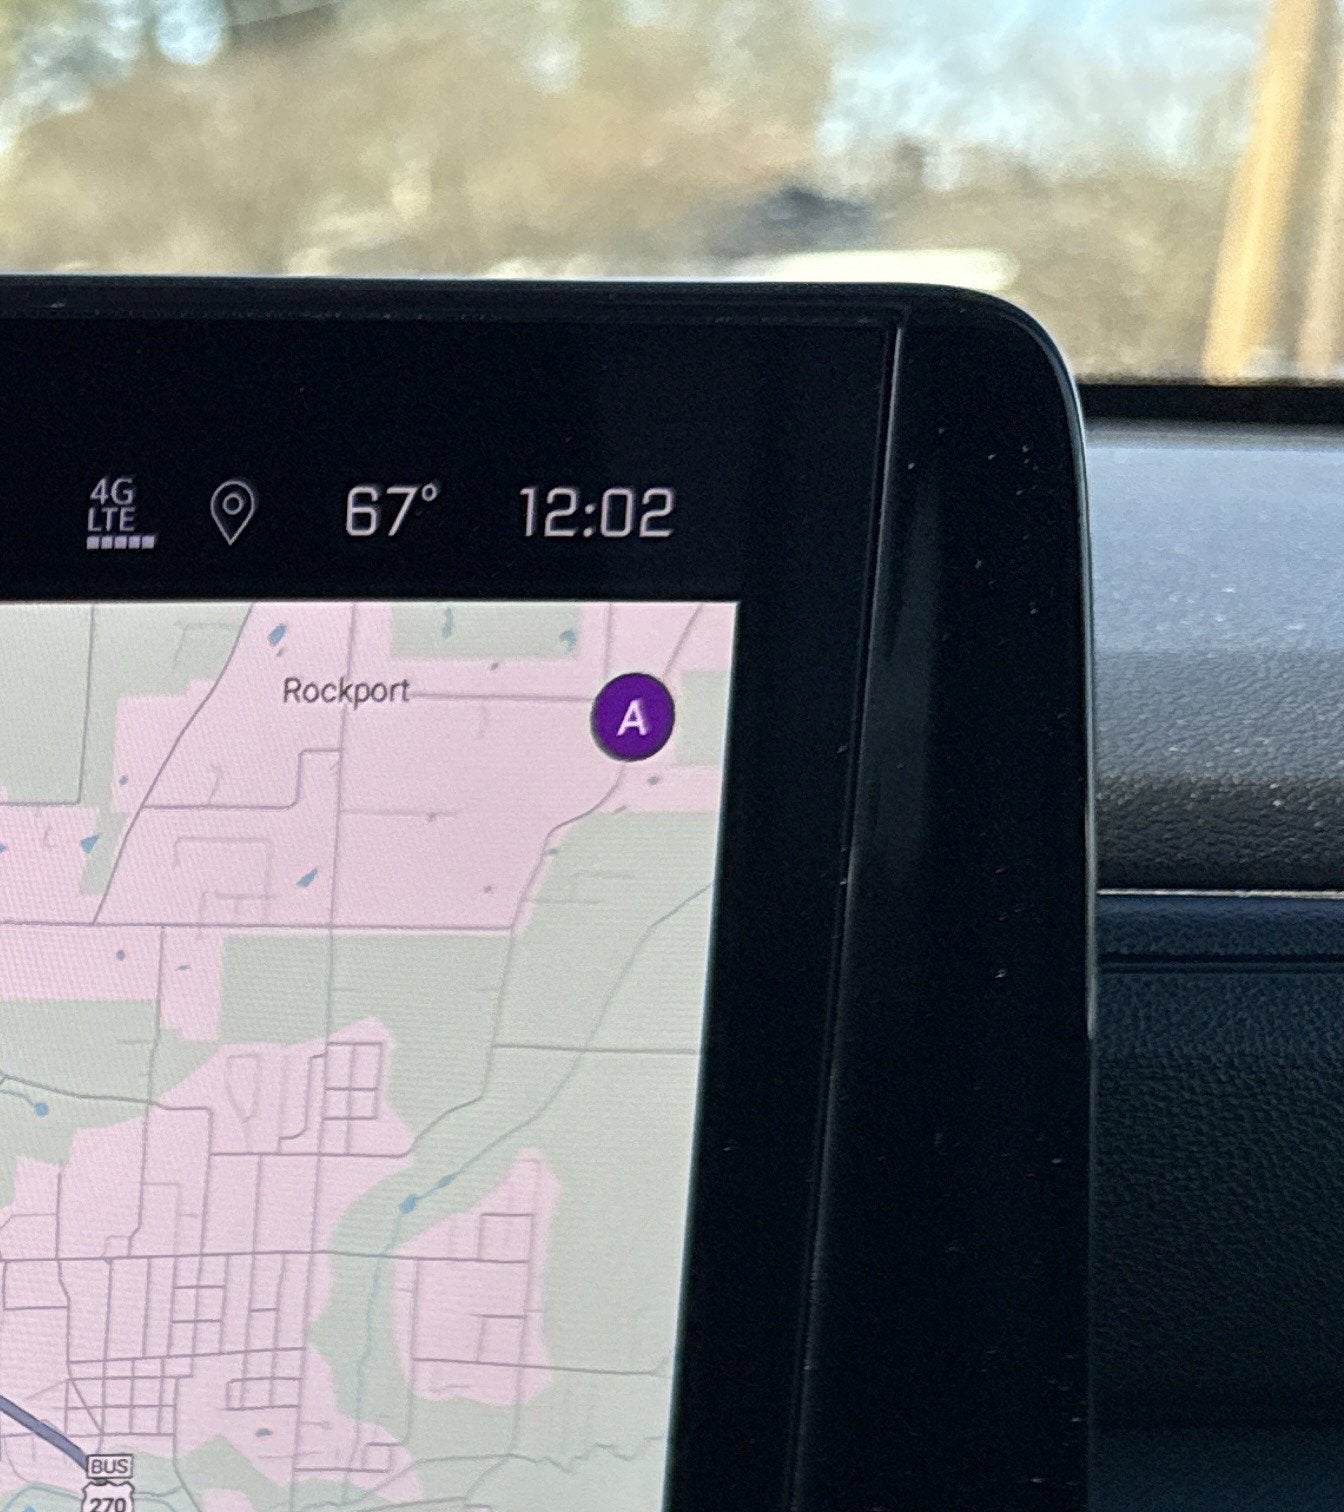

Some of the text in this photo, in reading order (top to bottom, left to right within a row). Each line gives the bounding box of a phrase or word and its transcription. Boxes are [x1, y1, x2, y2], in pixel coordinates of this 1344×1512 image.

[89, 478, 134, 504] 4G
[88, 508, 135, 532] LTE
[520, 487, 674, 538] 12:02
[283, 677, 410, 706] Rockport
[617, 700, 647, 736] A
[90, 1458, 128, 1475] BUS
